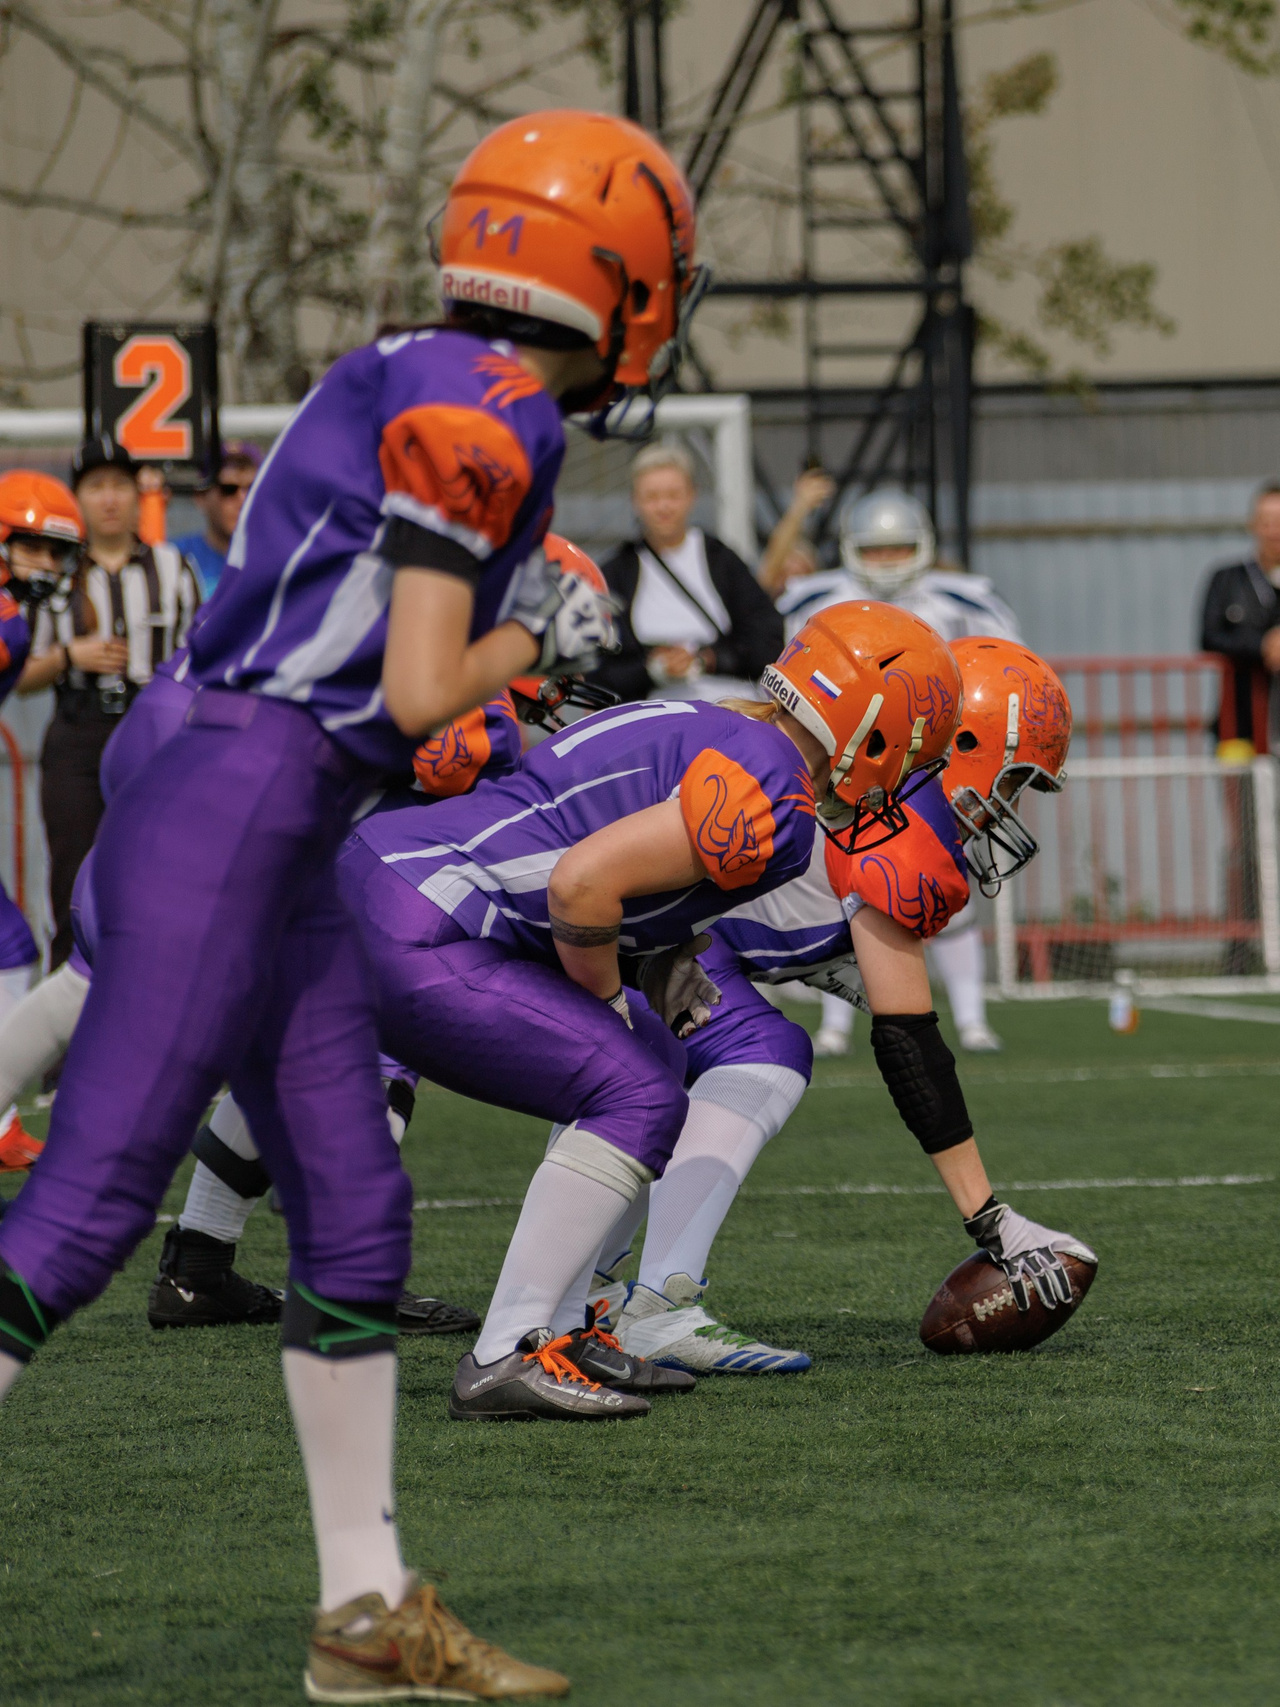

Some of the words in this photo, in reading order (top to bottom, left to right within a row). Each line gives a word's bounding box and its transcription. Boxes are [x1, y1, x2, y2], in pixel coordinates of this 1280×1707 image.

[468, 208, 524, 256] 11
[443, 273, 530, 311] Riddell
[113, 334, 192, 460] 2
[761, 667, 801, 712] Riddell
